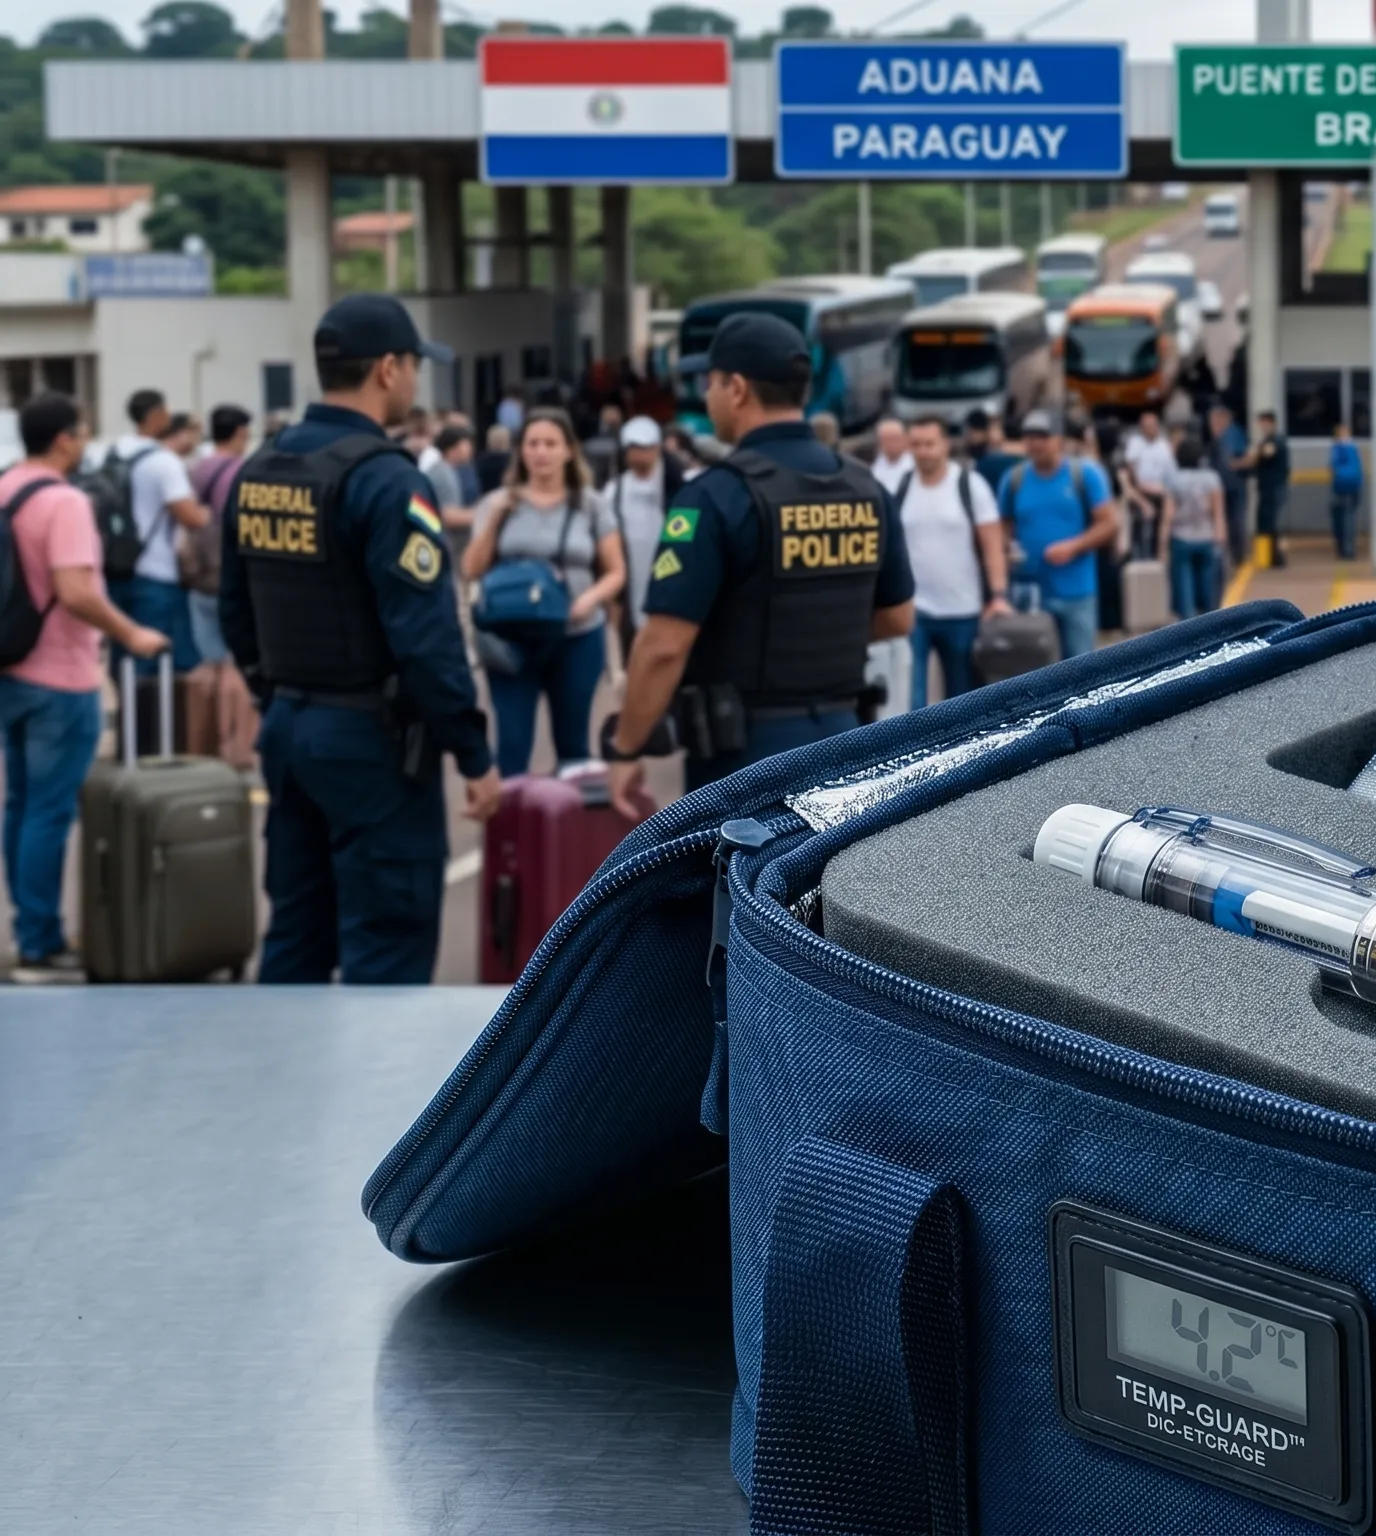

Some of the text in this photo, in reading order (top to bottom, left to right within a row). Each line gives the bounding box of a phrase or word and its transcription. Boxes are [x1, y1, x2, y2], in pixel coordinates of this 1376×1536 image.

[857, 58, 1043, 95] ADUANA
[1193, 64, 1325, 95] PUENTE
[833, 123, 1067, 160] PARAGUAY
[239, 482, 317, 514] FEDERAL
[780, 502, 879, 531] FEDERAL
[238, 514, 318, 554] POLICE
[781, 532, 879, 570] POLICE
[1147, 1413, 1266, 1467] DIC-ETCRAGE
